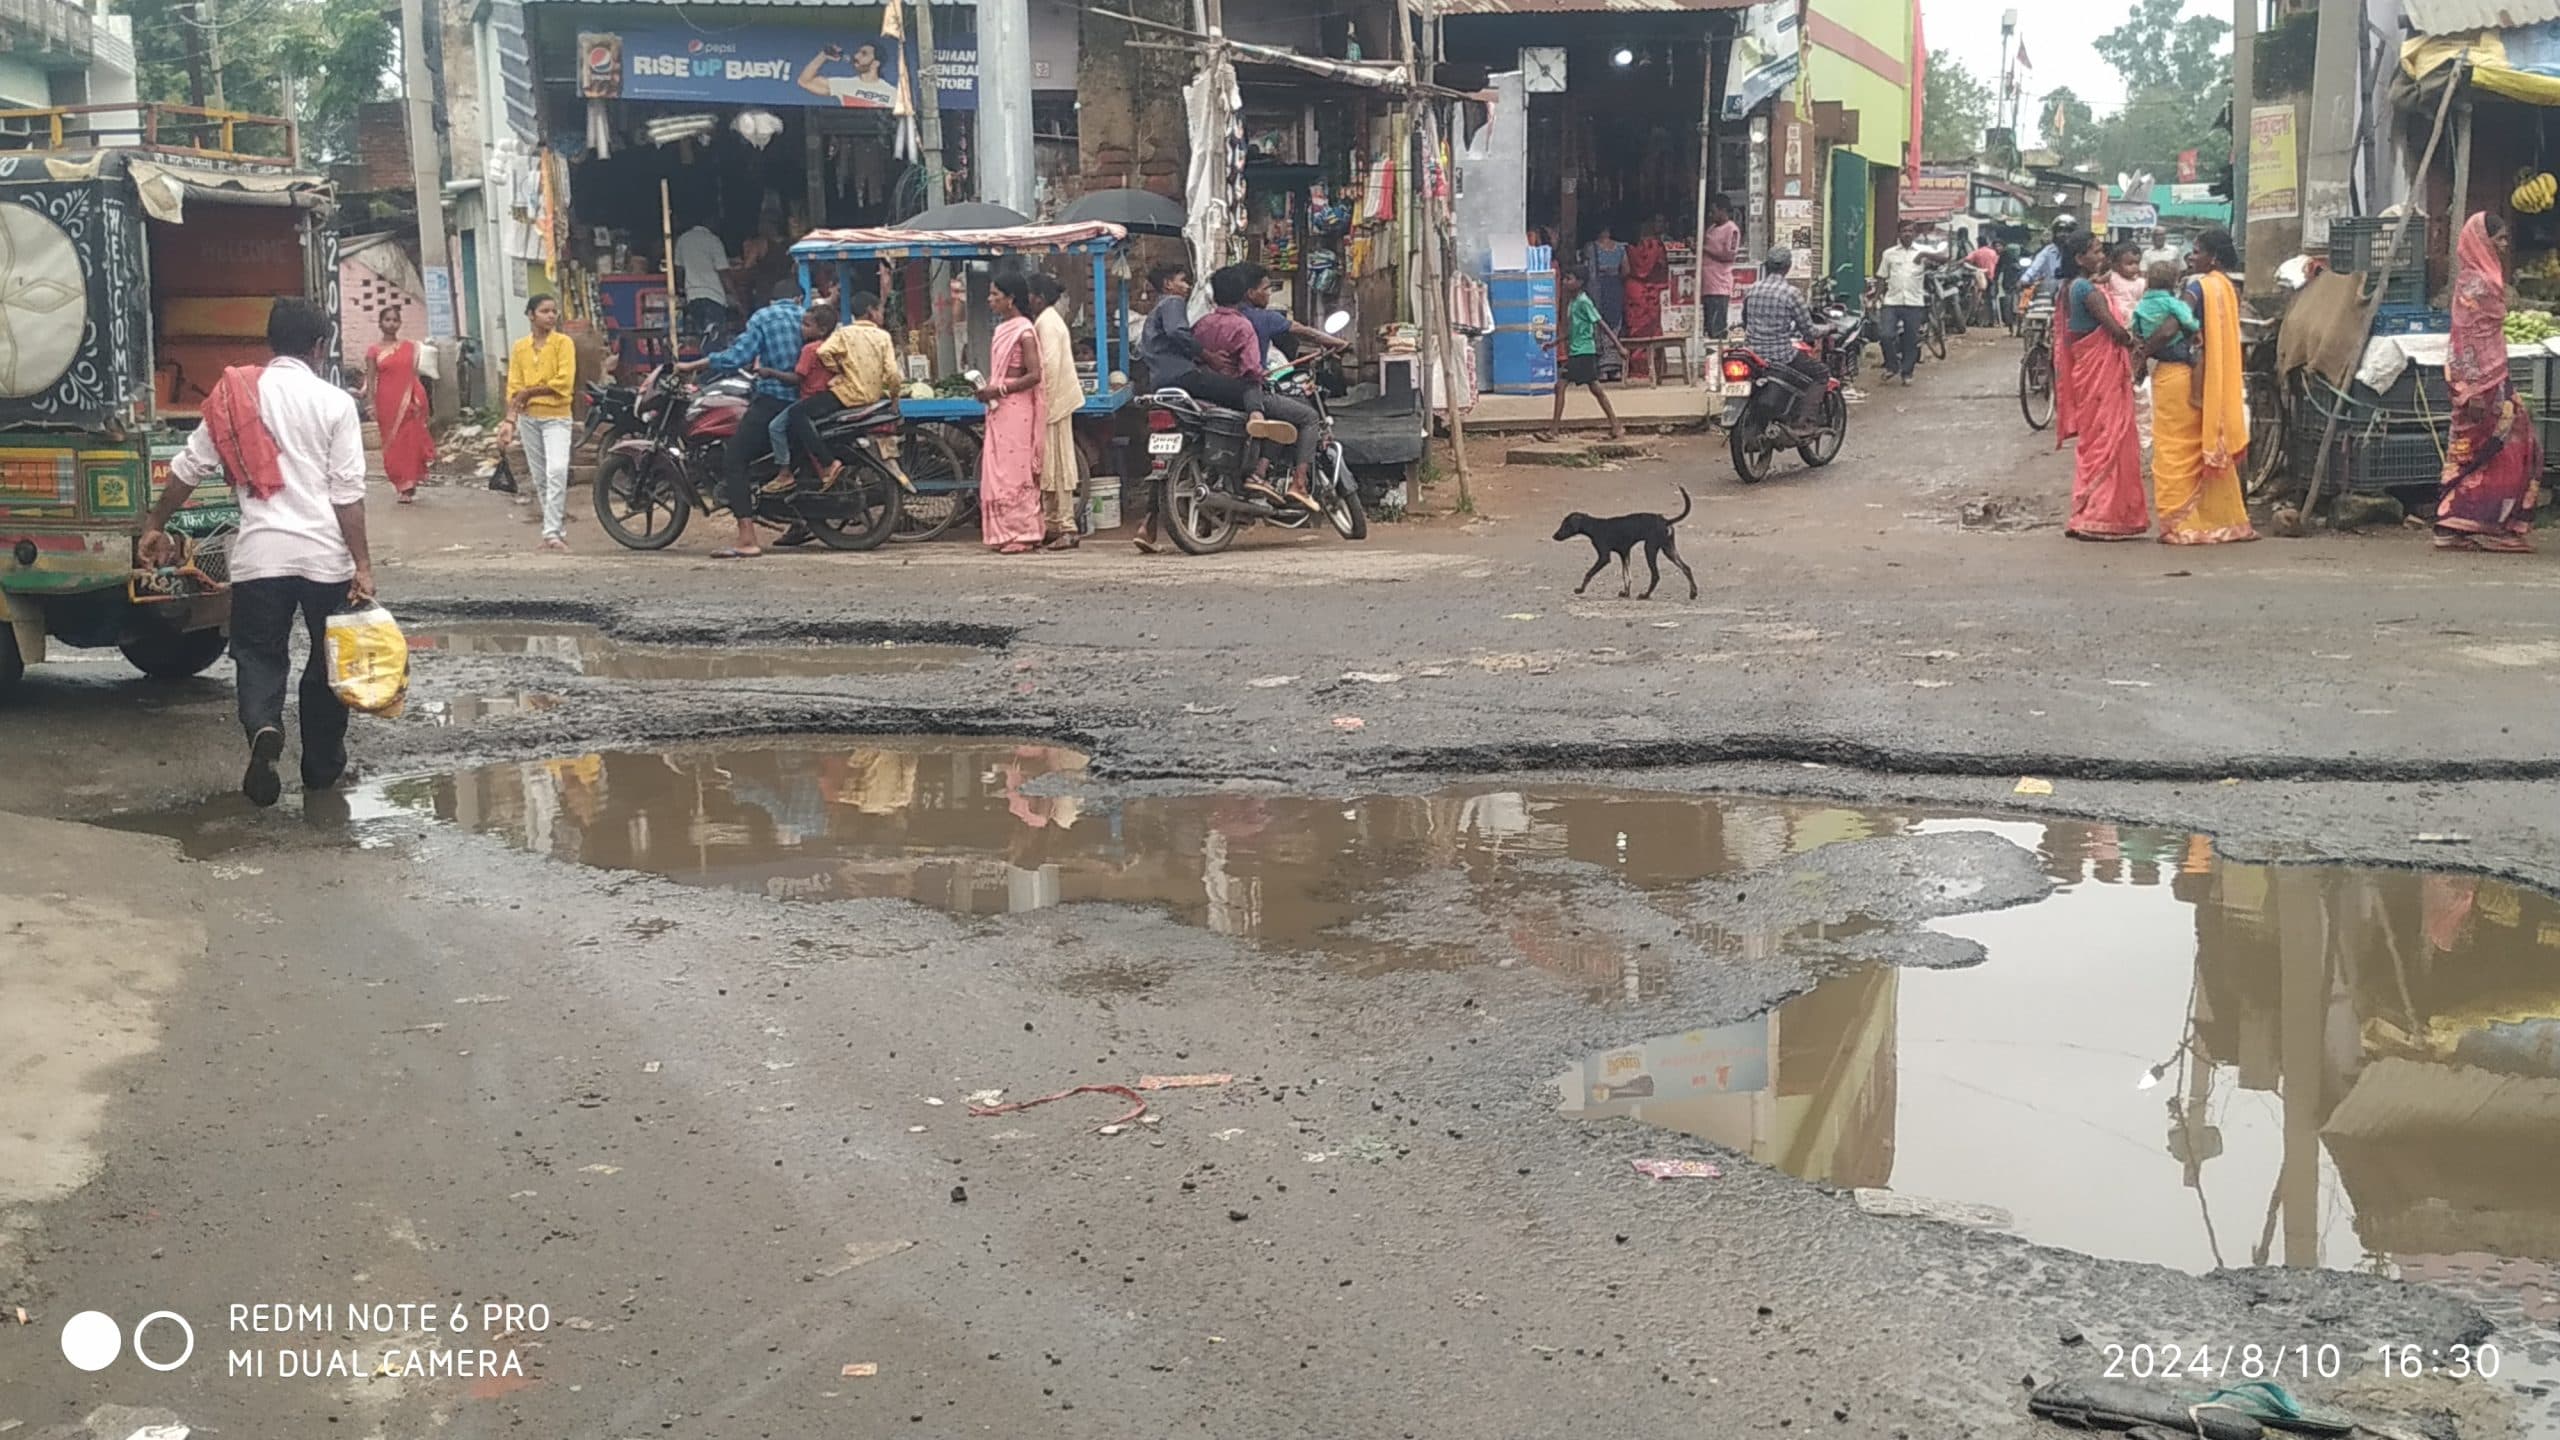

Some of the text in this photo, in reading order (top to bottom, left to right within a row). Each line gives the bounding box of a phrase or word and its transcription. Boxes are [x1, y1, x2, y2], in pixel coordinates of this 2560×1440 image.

[632, 55, 792, 81] RISE UP BABY!
[703, 42, 736, 54] pepsi
[109, 208, 129, 400] WELCOME
[327, 236, 341, 388] 2020
